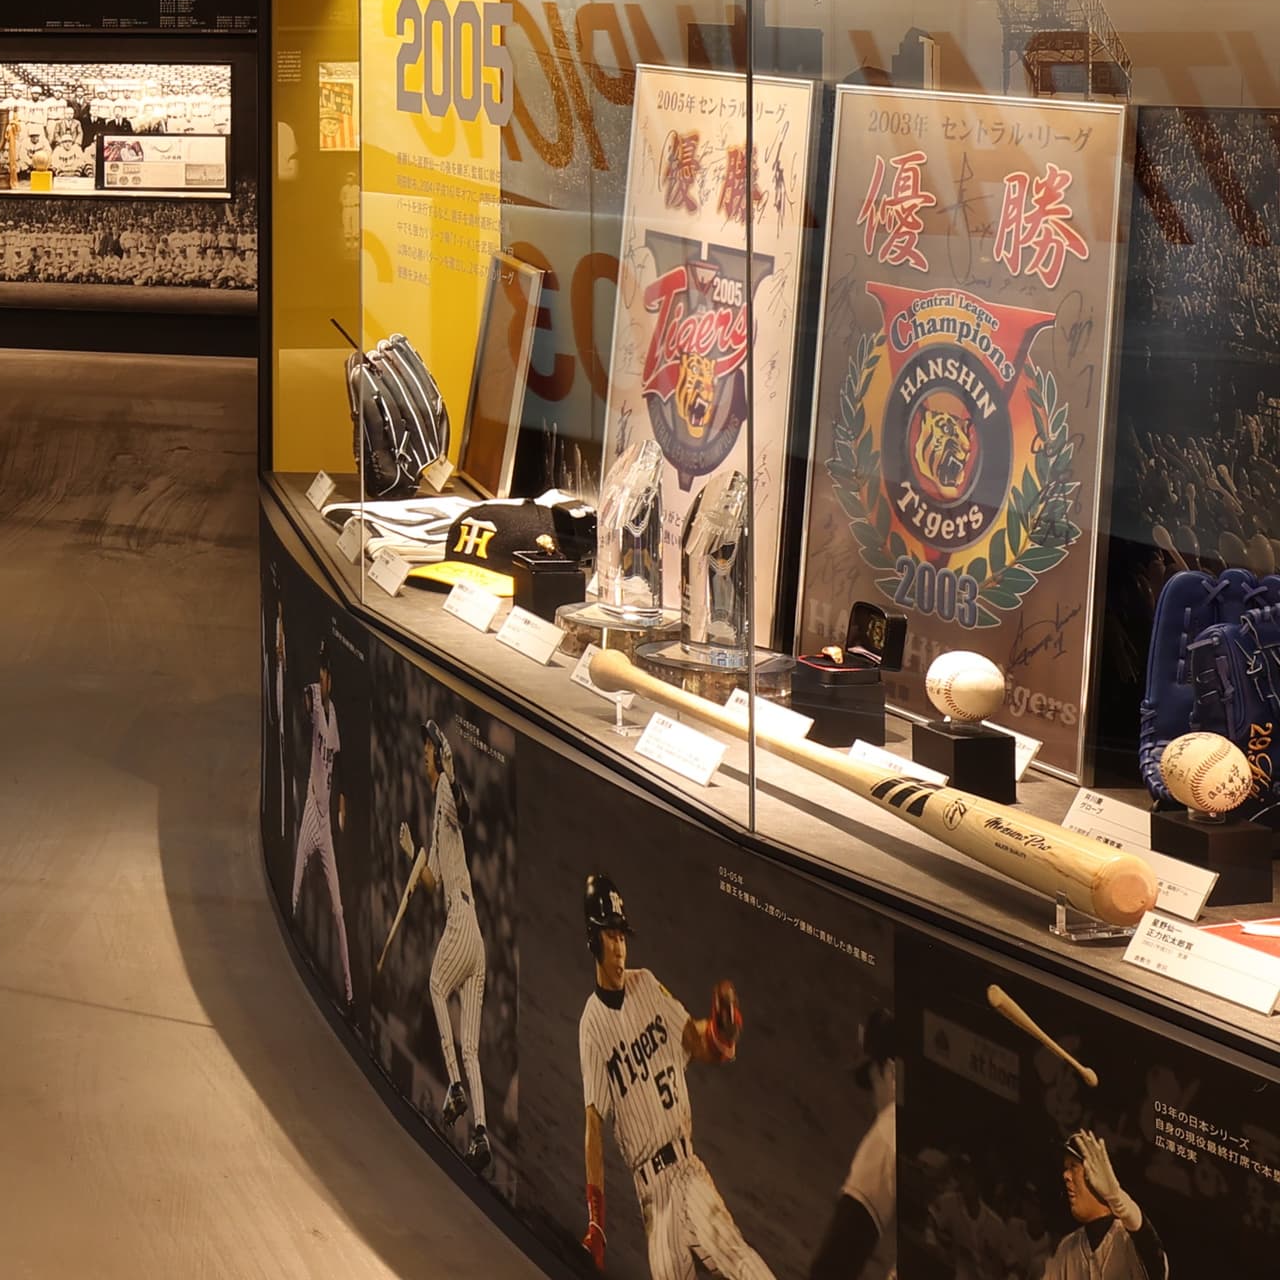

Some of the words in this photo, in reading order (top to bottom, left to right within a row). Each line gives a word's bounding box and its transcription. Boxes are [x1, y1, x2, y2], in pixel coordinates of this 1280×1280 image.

[656, 89, 696, 115] 2005年
[698, 95, 788, 124] セントラルリーグ
[867, 109, 929, 140] 2003年
[940, 115, 1094, 153] セントラル・リーグ
[712, 275, 743, 308] 2005
[912, 294, 955, 313] Central
[957, 294, 1000, 332] League
[890, 310, 1016, 383] Champions
[898, 356, 997, 421] HANSHIN
[896, 480, 985, 541] Tigers
[894, 554, 981, 630] 2003
[1003, 671, 1078, 726] igers
[1145, 926, 1195, 952] 正力松太郎賞
[606, 1013, 668, 1098] Tigers
[1153, 1099, 1251, 1152] 03年の日本シリーズ
[1154, 1135, 1199, 1165] 広澤克実
